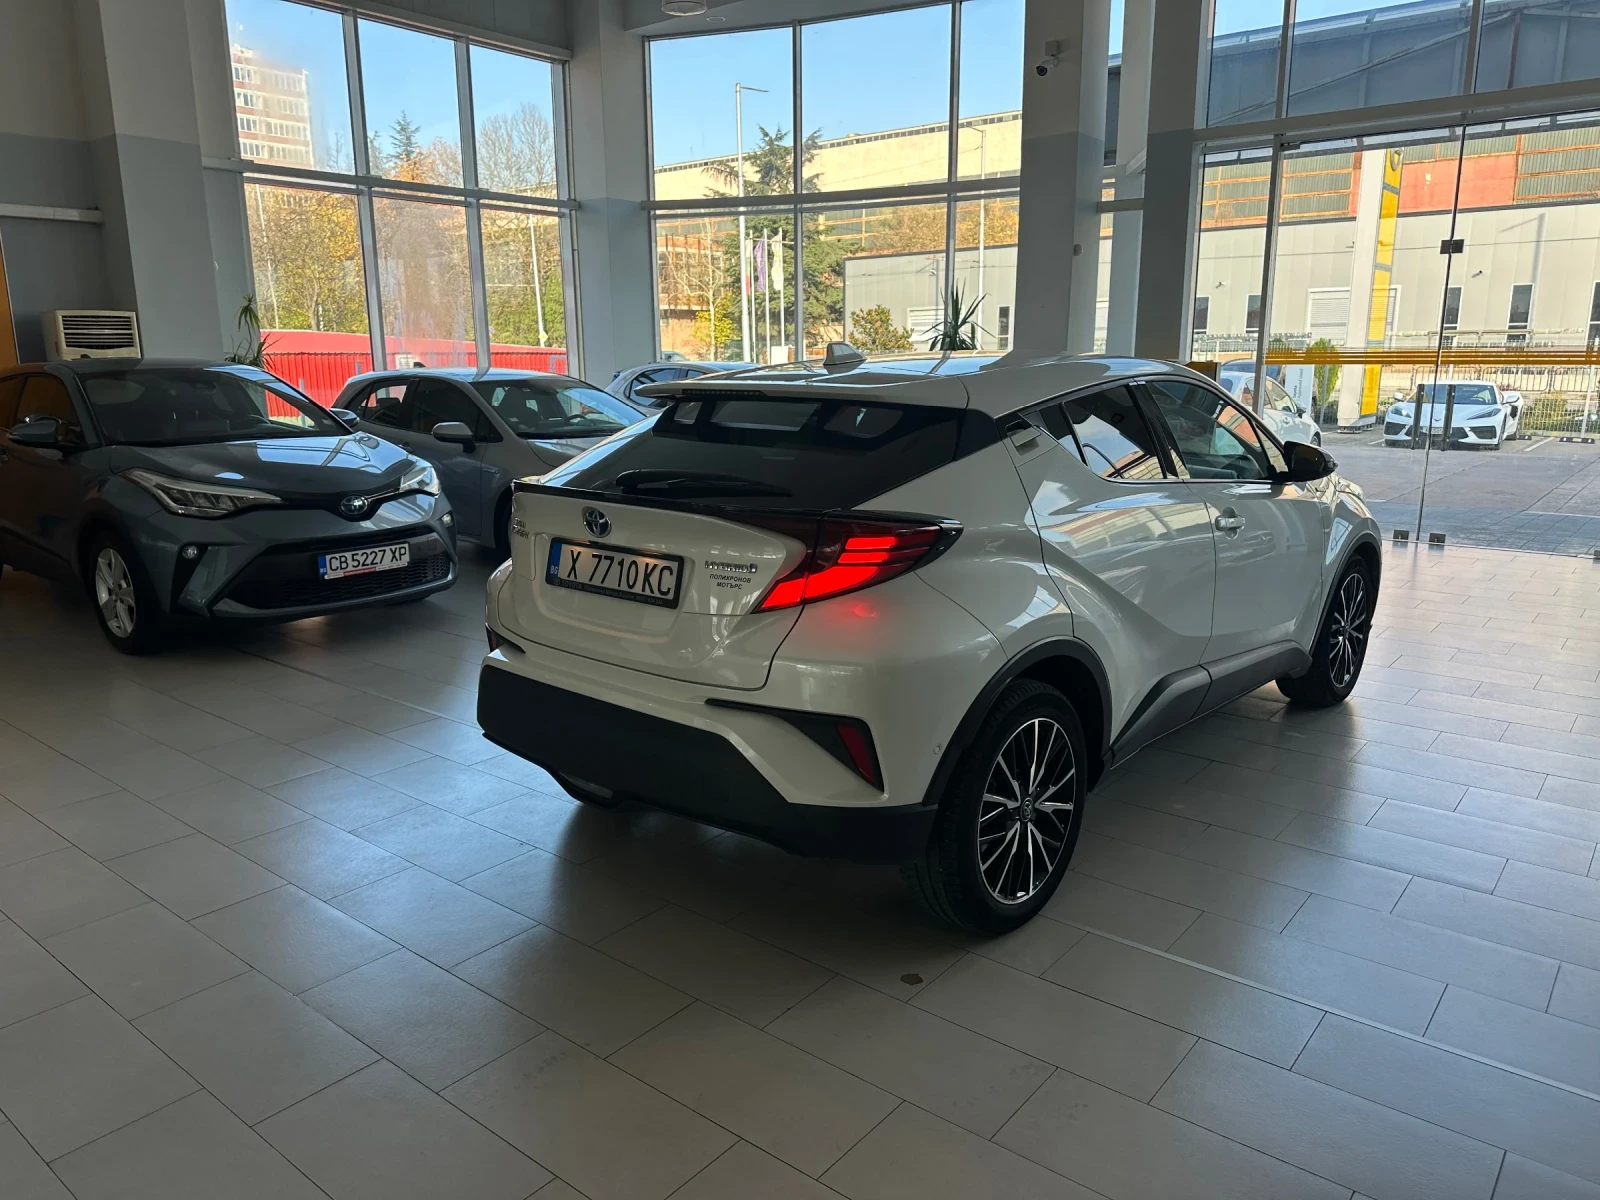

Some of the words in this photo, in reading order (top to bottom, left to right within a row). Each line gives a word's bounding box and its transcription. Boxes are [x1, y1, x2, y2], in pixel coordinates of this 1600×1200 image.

[329, 555, 349, 572] CB
[351, 549, 387, 569] 5227
[389, 546, 407, 563] XP
[567, 549, 582, 580] X
[550, 565, 559, 575] BG
[710, 574, 752, 584] ПОЛИХРОНОВ
[717, 582, 743, 590] МОТЪРС
